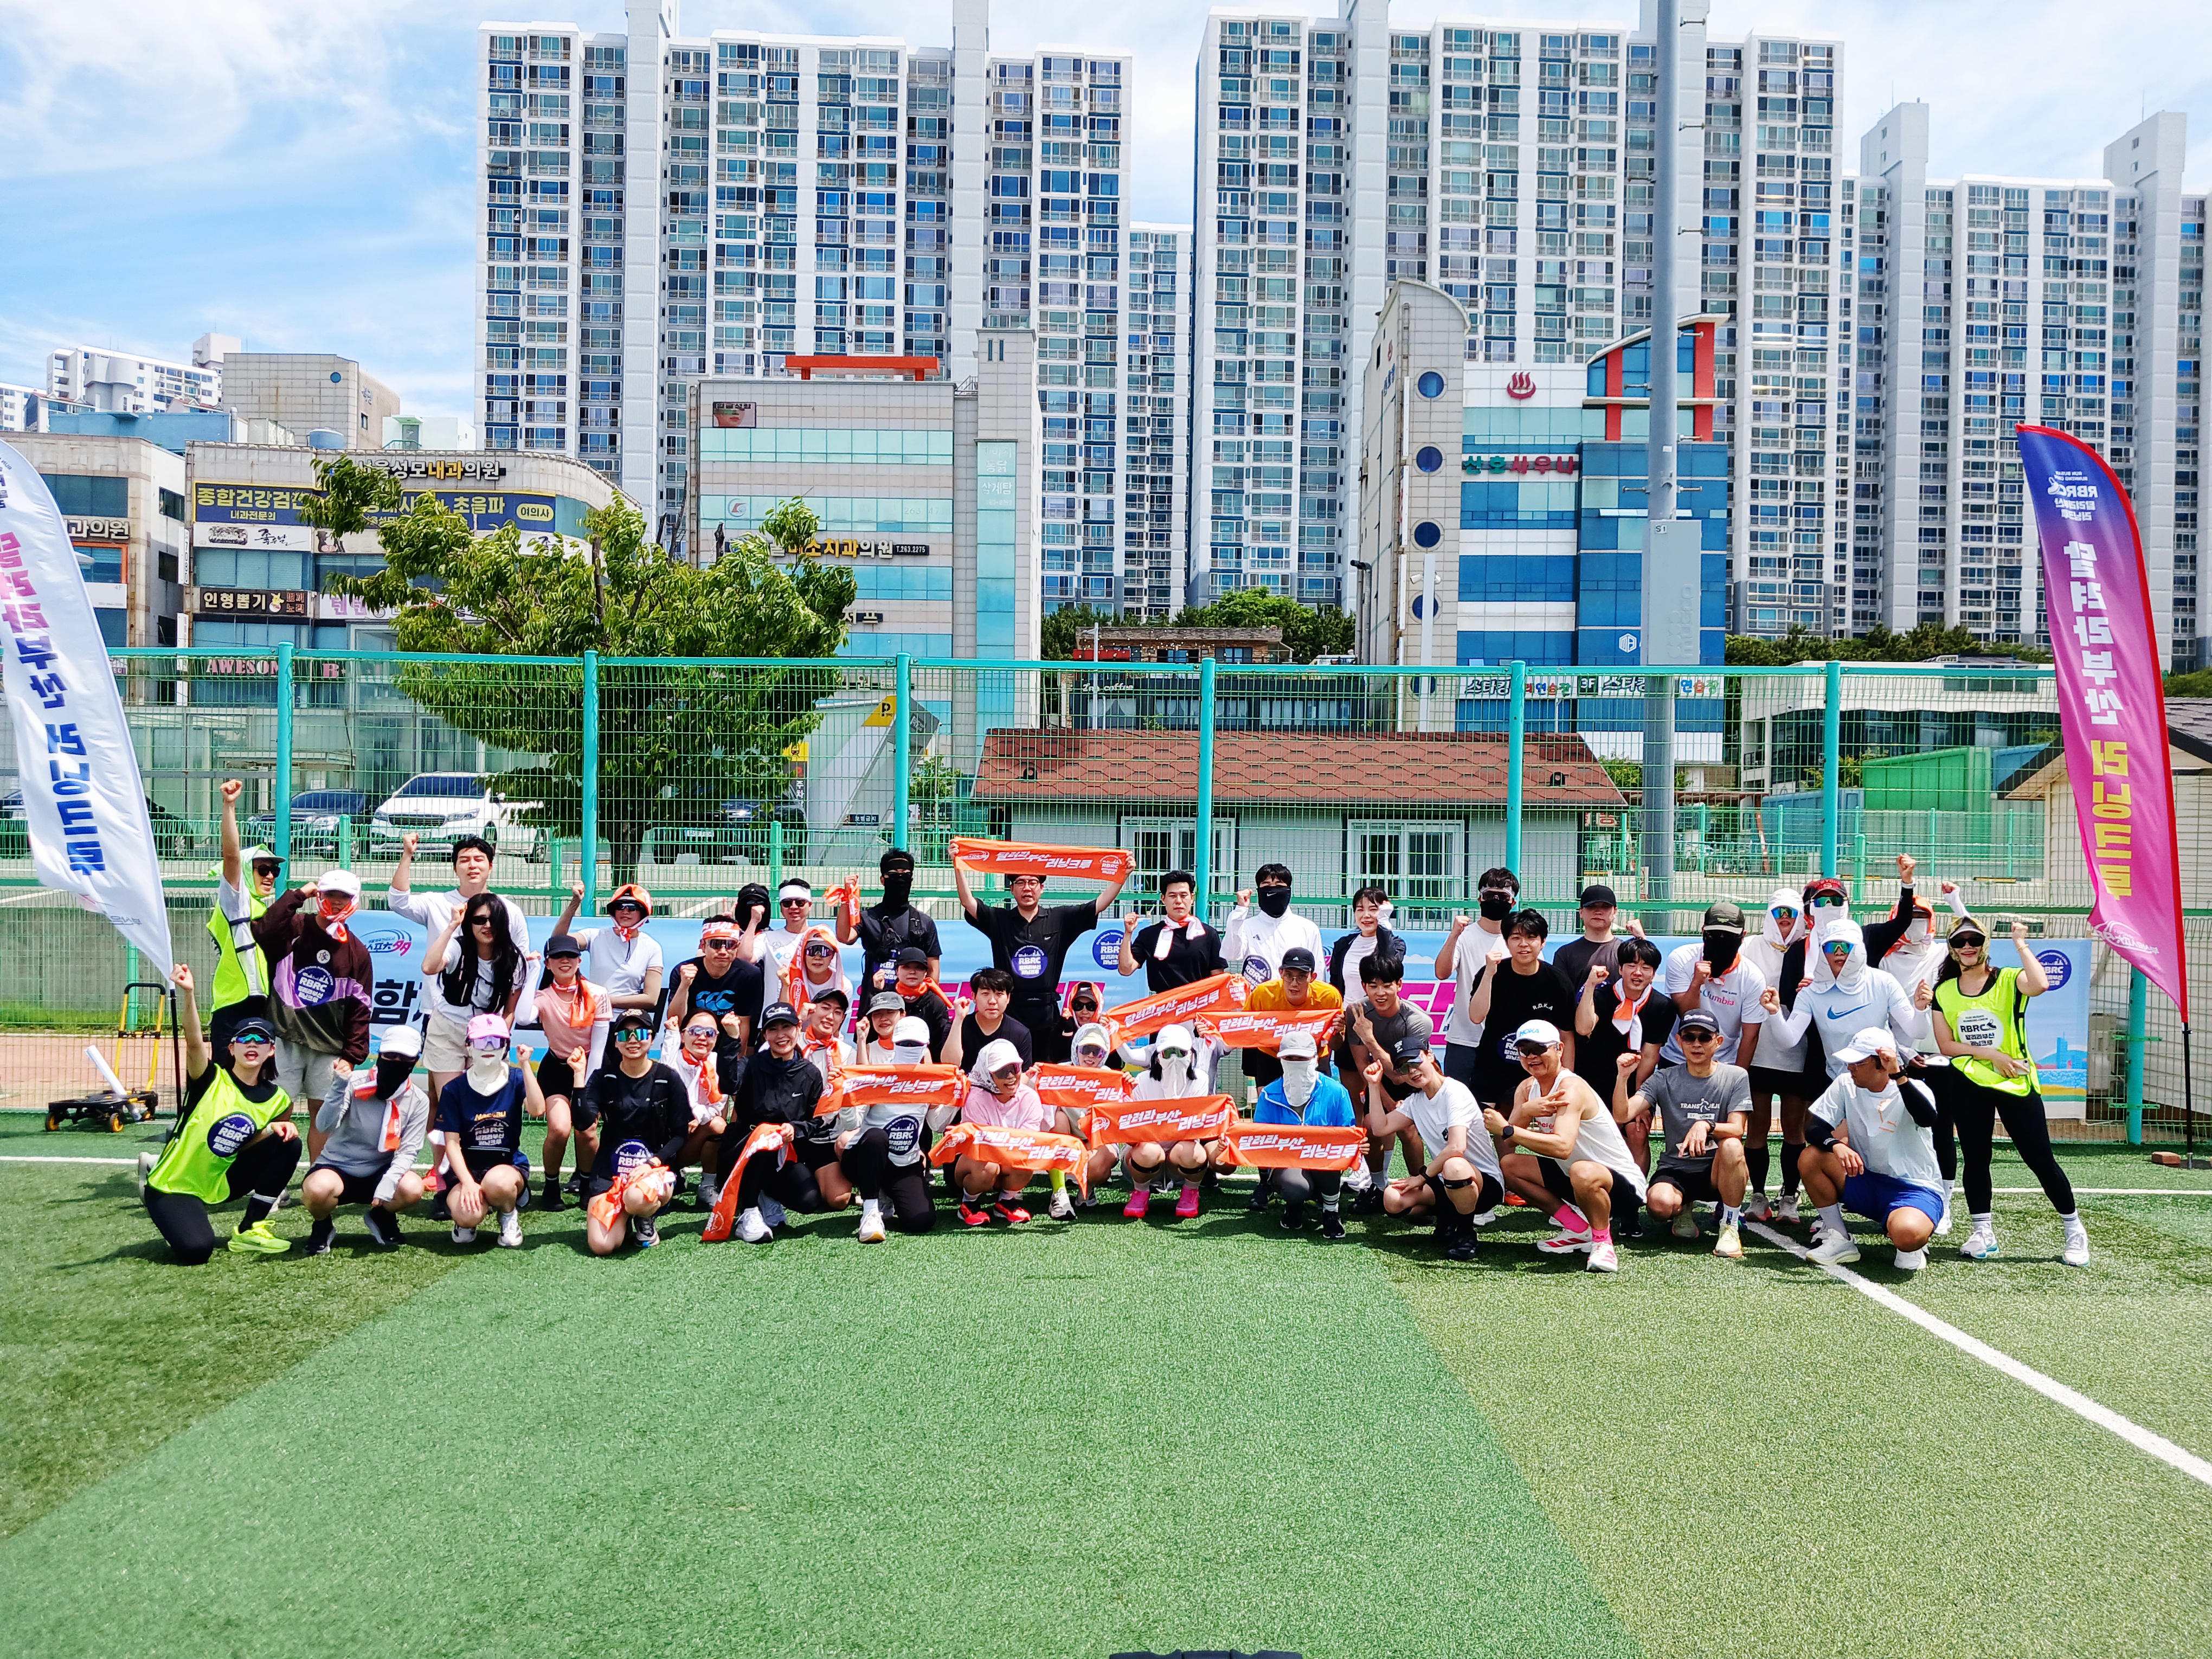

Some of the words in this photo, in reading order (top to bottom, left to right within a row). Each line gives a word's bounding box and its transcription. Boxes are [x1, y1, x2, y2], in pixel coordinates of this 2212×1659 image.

[982, 481, 1012, 495] 삼계탕
[453, 496, 505, 515] 초음파
[520, 506, 550, 518] 여의사
[230, 510, 276, 521] 내과전문의
[63, 518, 130, 540] 과의원
[203, 592, 266, 610] 인형뽑기
[286, 603, 305, 614] 노리
[205, 659, 295, 674] AWESOM
[1581, 678, 1595, 690] 3F
[1680, 679, 1719, 695] 연습장
[882, 703, 891, 717] P
[995, 850, 1052, 862] 달려라부산
[1045, 857, 1093, 869] 러닝크루
[1100, 946, 1121, 954] RBR
[1018, 956, 1041, 964] RBRC
[299, 976, 328, 993] RBRC
[1700, 988, 1735, 1006] olumbia
[1124, 999, 1178, 1028] 달려라부산
[1175, 989, 1220, 1017] 러닝크루
[1219, 1015, 1278, 1033] 달려라부산
[1273, 1020, 1326, 1038] 러닝크루
[1960, 1024, 1986, 1033] RBRC
[1094, 1087, 1126, 1103] 러닝
[1118, 1109, 1182, 1130] 달려라부산
[1177, 1109, 1229, 1131] 러닝크루
[888, 1130, 914, 1140] RBRC
[973, 1129, 1036, 1150] 달려라부산
[1027, 1144, 1082, 1161] 러닝크루
[1238, 1134, 1306, 1151] 달려라부산
[1300, 1143, 1360, 1160] 러닝크루
